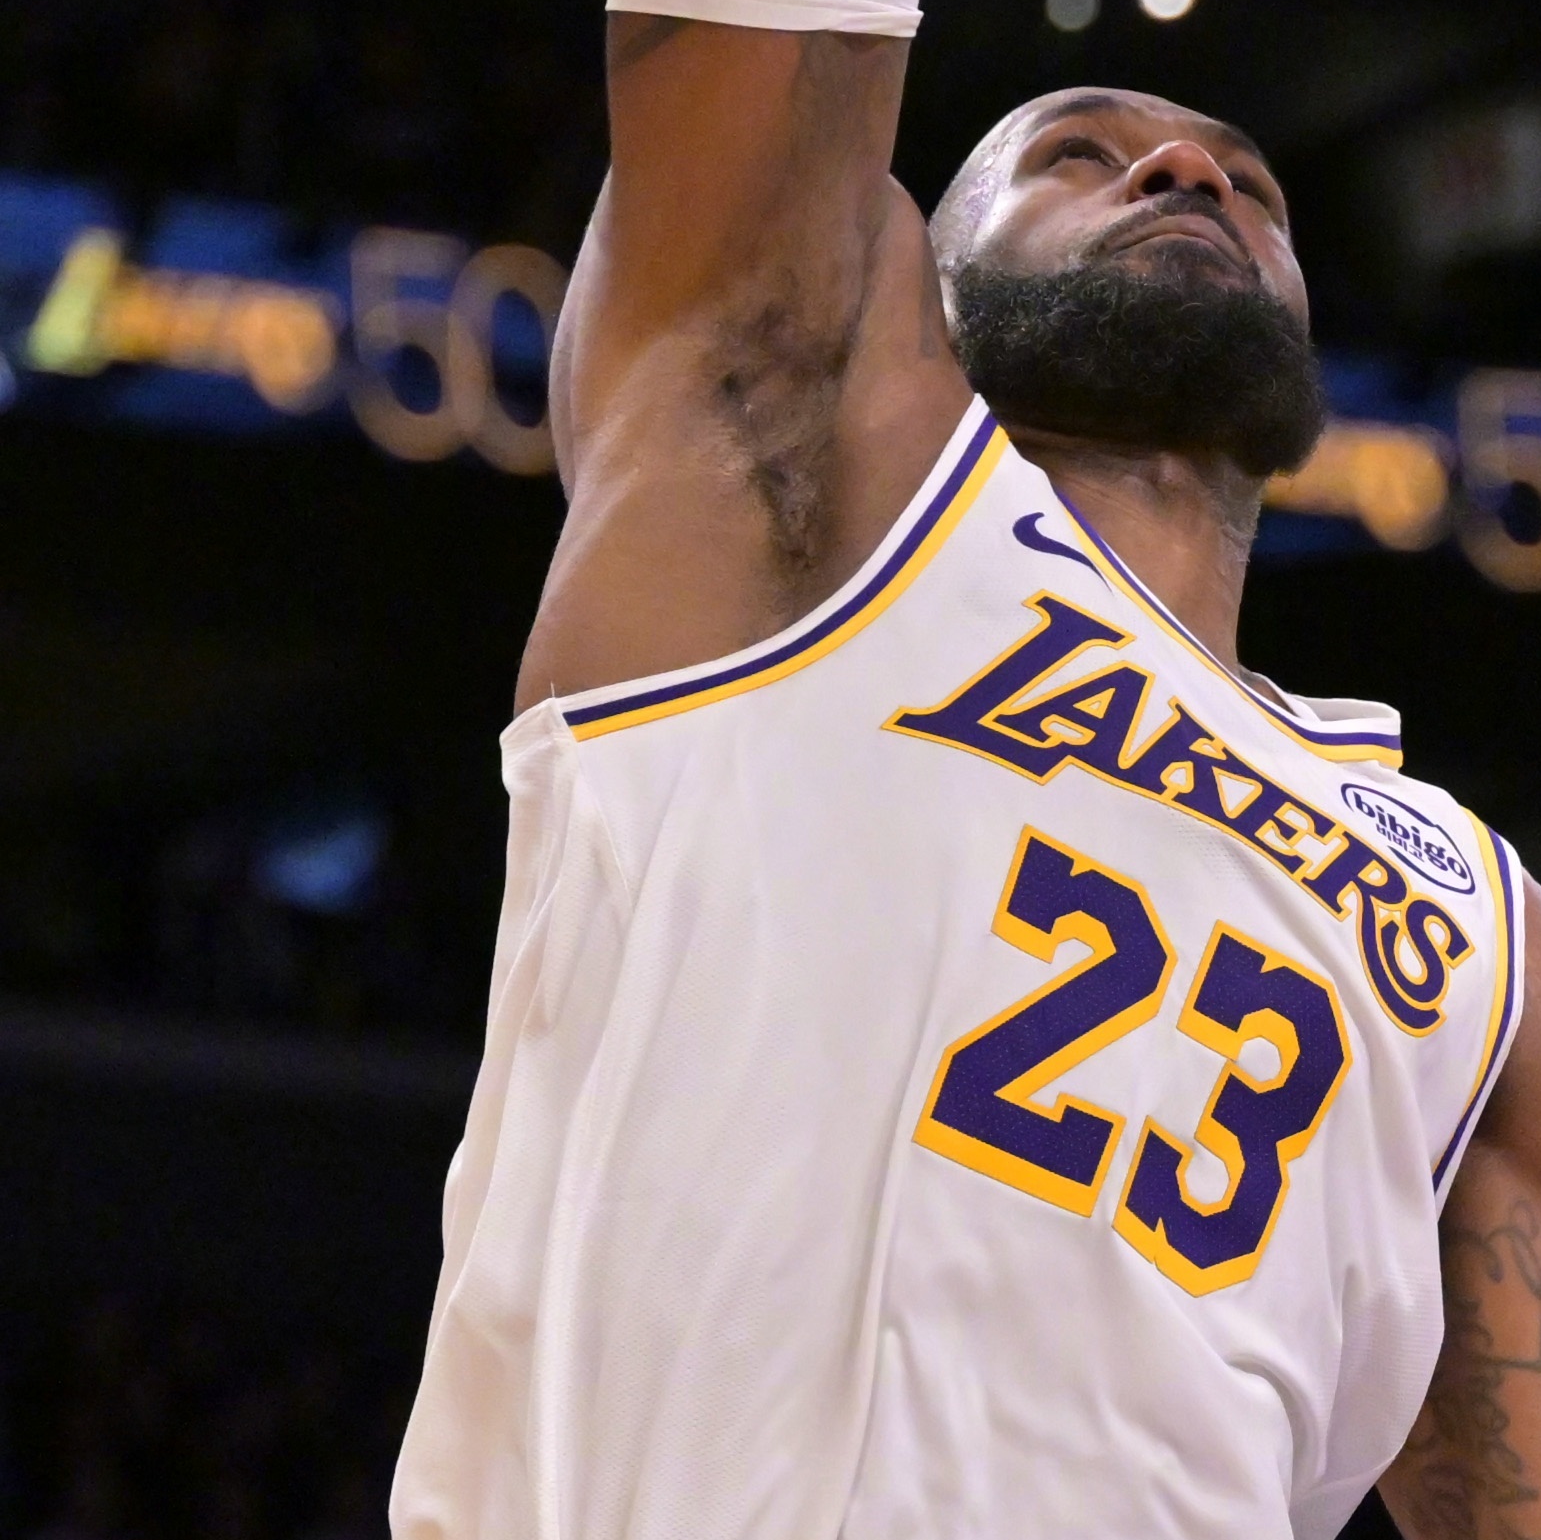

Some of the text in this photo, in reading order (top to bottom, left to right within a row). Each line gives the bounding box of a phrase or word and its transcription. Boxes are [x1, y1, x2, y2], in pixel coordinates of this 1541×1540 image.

[881, 589, 1476, 1037] LAKERS
[1353, 790, 1468, 880] bibigo
[912, 823, 1353, 1299] 23
